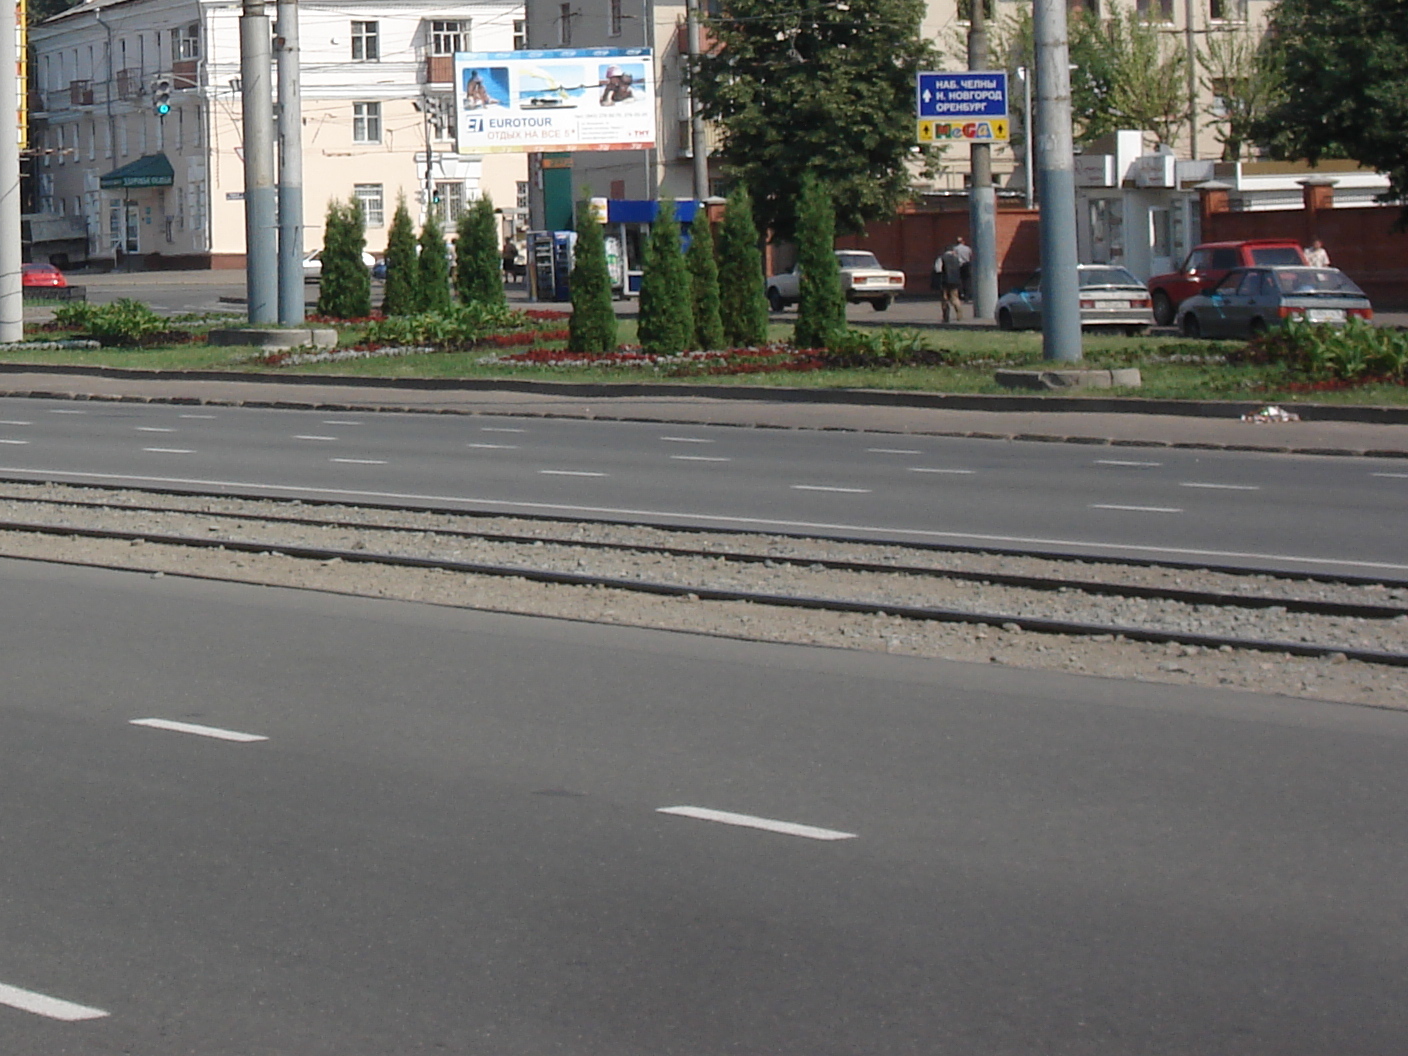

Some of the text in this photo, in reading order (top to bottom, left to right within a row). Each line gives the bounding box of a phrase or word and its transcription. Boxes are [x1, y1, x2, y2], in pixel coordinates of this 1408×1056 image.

[935, 79, 997, 90] НАБ. ЧЕЛНЫ
[935, 90, 1003, 101] Н. НОВГОРОД
[935, 102, 988, 112] ОРЕНБУРГ
[489, 117, 552, 128] EUROTOUR
[487, 131, 522, 141] ОТДЫХ
[525, 130, 539, 139] НА
